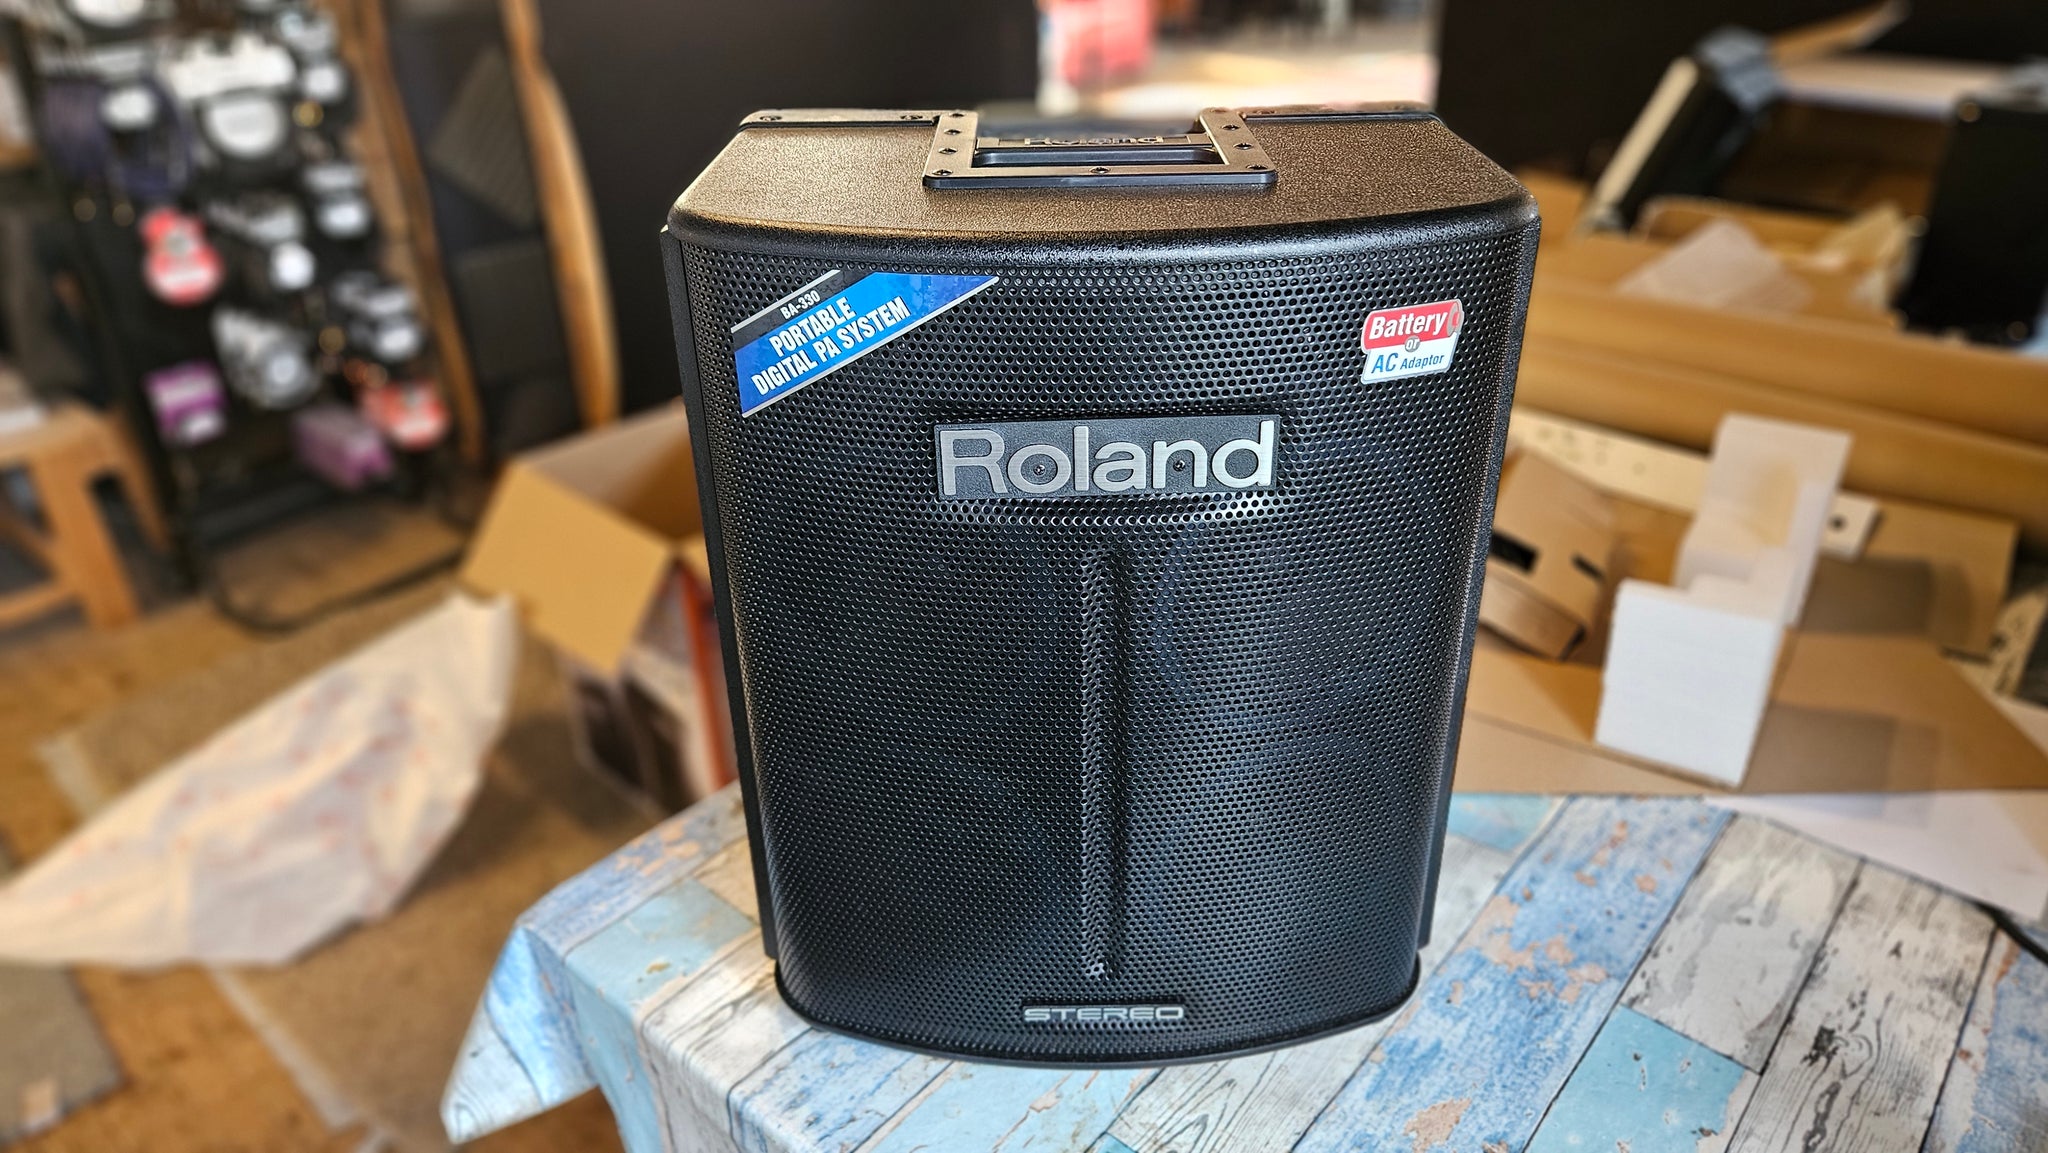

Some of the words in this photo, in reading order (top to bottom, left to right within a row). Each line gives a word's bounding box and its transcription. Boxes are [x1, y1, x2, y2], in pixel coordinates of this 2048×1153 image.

[780, 290, 821, 319] BA-330
[769, 297, 857, 357] PORTABLE
[1369, 312, 1448, 339] Battery
[751, 353, 818, 396] DIGITAL
[812, 335, 842, 363] PA
[842, 296, 911, 349] SYSTEM
[1406, 339, 1420, 350] or
[1371, 352, 1399, 374] AC
[1400, 354, 1444, 369] Adaptor
[939, 420, 1275, 496] Roland
[1024, 1006, 1184, 1022] STEREO
